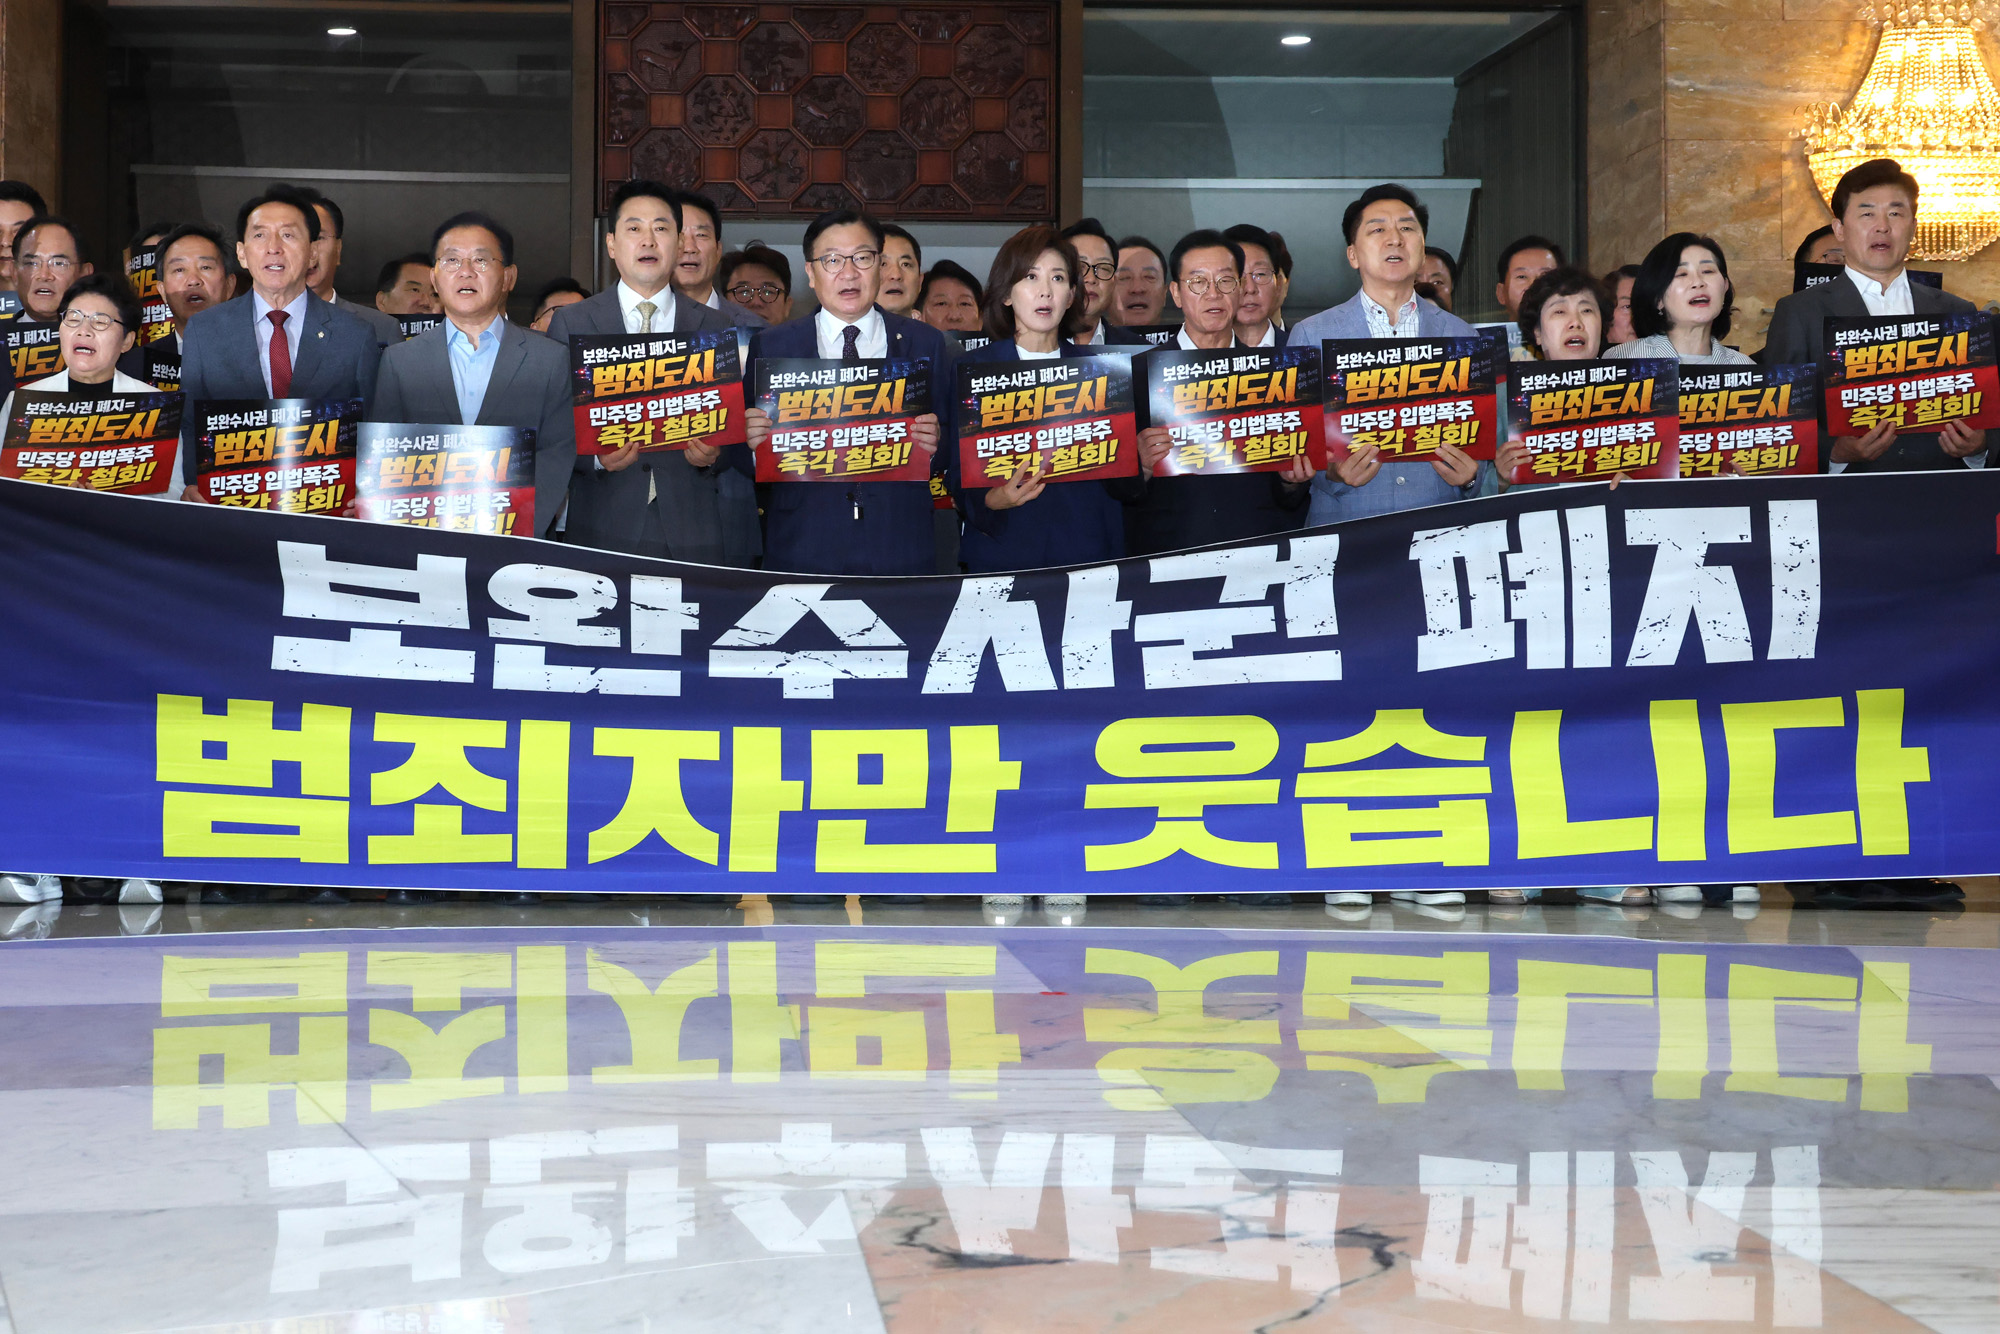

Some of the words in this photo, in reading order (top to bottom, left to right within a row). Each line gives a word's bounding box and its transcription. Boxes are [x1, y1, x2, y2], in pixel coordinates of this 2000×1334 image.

[583, 342, 646, 364] 보완수사권
[1835, 326, 1898, 347] 보완수사권
[1163, 358, 1230, 382] 보완수사권
[1336, 348, 1401, 370] 보완수사권
[1844, 331, 1969, 380] 범죄도시
[592, 349, 715, 397] 범죄도시
[769, 369, 836, 389] 보완수사권
[971, 370, 1036, 393] 보완수사권
[1345, 357, 1471, 404] 범죄도시
[1521, 369, 1586, 392] 보완수사권
[777, 378, 906, 423] 범죄도시
[980, 376, 1109, 428] 범죄도시
[1173, 367, 1298, 416] 범죄도시
[1530, 378, 1655, 425] 범죄도시
[1840, 384, 1896, 408] 민주당
[1898, 373, 1976, 401] 입법폭주
[25, 401, 92, 415] 보완수사권
[207, 409, 267, 431] 보완수사권
[589, 402, 644, 426] 민주당
[646, 390, 721, 418] 입법폭주
[1340, 409, 1397, 433] 민주당
[1400, 400, 1475, 427] 입법폭주
[1848, 404, 1908, 429] 즉각
[1913, 392, 1982, 424] 철회!
[27, 408, 161, 444] 범죄도시
[213, 419, 339, 467] 범죄도시
[597, 421, 655, 448] 즉각
[661, 408, 728, 441] 철회!
[772, 428, 828, 453] 민주당
[831, 422, 907, 447] 입법폭주
[976, 432, 1033, 458] 민주당
[1035, 419, 1113, 450] 입법폭주
[1168, 421, 1225, 446] 민주당
[1228, 411, 1302, 438] 입법폭주
[1412, 421, 1480, 451] 철회!
[1525, 430, 1580, 454] 민주당
[1582, 421, 1656, 445] 입법폭주
[1679, 432, 1714, 453] 주당
[1716, 425, 1794, 450] 입법폭주
[17, 451, 76, 468] 민주당
[78, 445, 155, 467] 입법폭주
[777, 451, 837, 475] 즉각
[844, 442, 913, 472] 철회!
[1050, 439, 1119, 472] 철회!
[1176, 440, 1237, 469] 즉각
[1242, 431, 1308, 462] 철회!
[1531, 451, 1588, 477] 즉각
[1593, 441, 1662, 471] 철회!
[86, 461, 158, 487] 철회!
[209, 472, 262, 496] 민주당
[265, 463, 341, 491] 입법폭주
[379, 447, 511, 489] 범죄도시
[280, 484, 346, 513] 철회!
[270, 533, 1343, 700] 보완수사권
[1408, 499, 1820, 673] 폐지
[155, 692, 1022, 874] 범죄자만
[1083, 687, 1931, 872] 웃습니다
